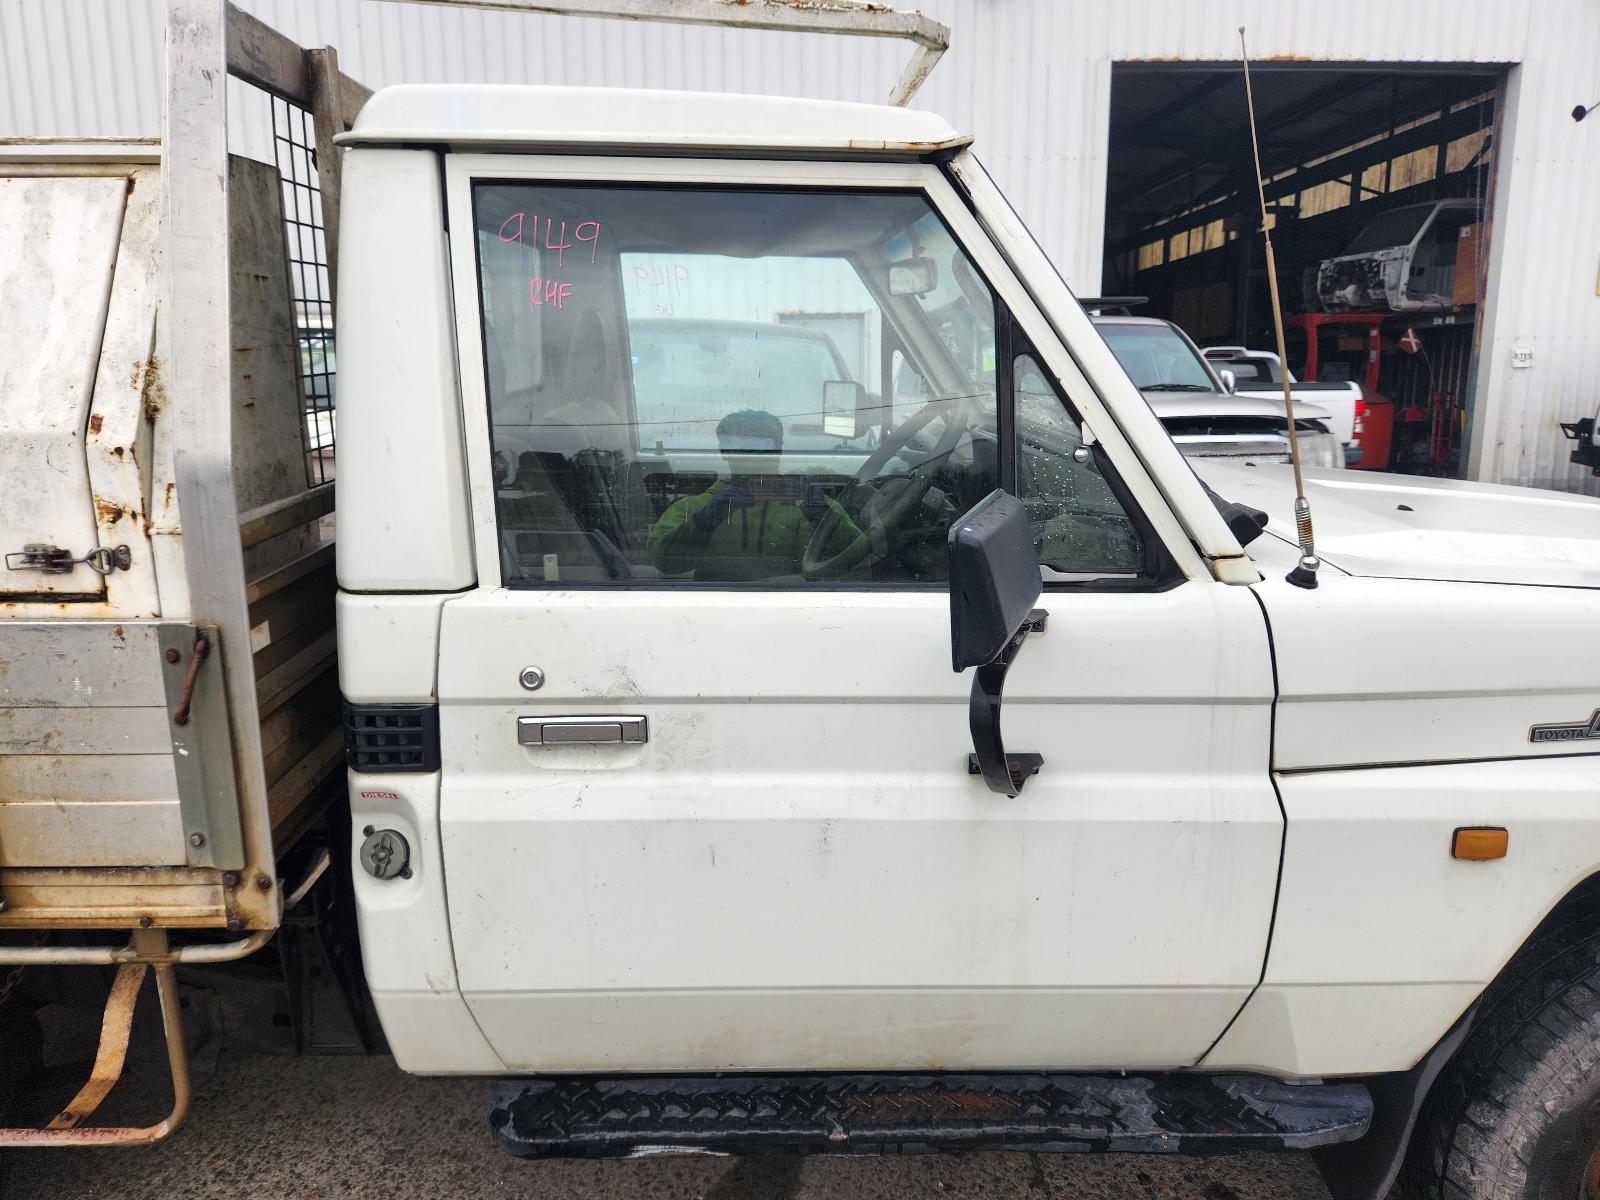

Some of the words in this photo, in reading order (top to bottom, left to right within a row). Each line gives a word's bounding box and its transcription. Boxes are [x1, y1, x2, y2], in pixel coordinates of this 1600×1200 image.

[499, 213, 601, 267] 9149
[529, 277, 573, 312] RHF
[1536, 729, 1585, 740] TOYOTA
[362, 791, 398, 800] DIESEL
